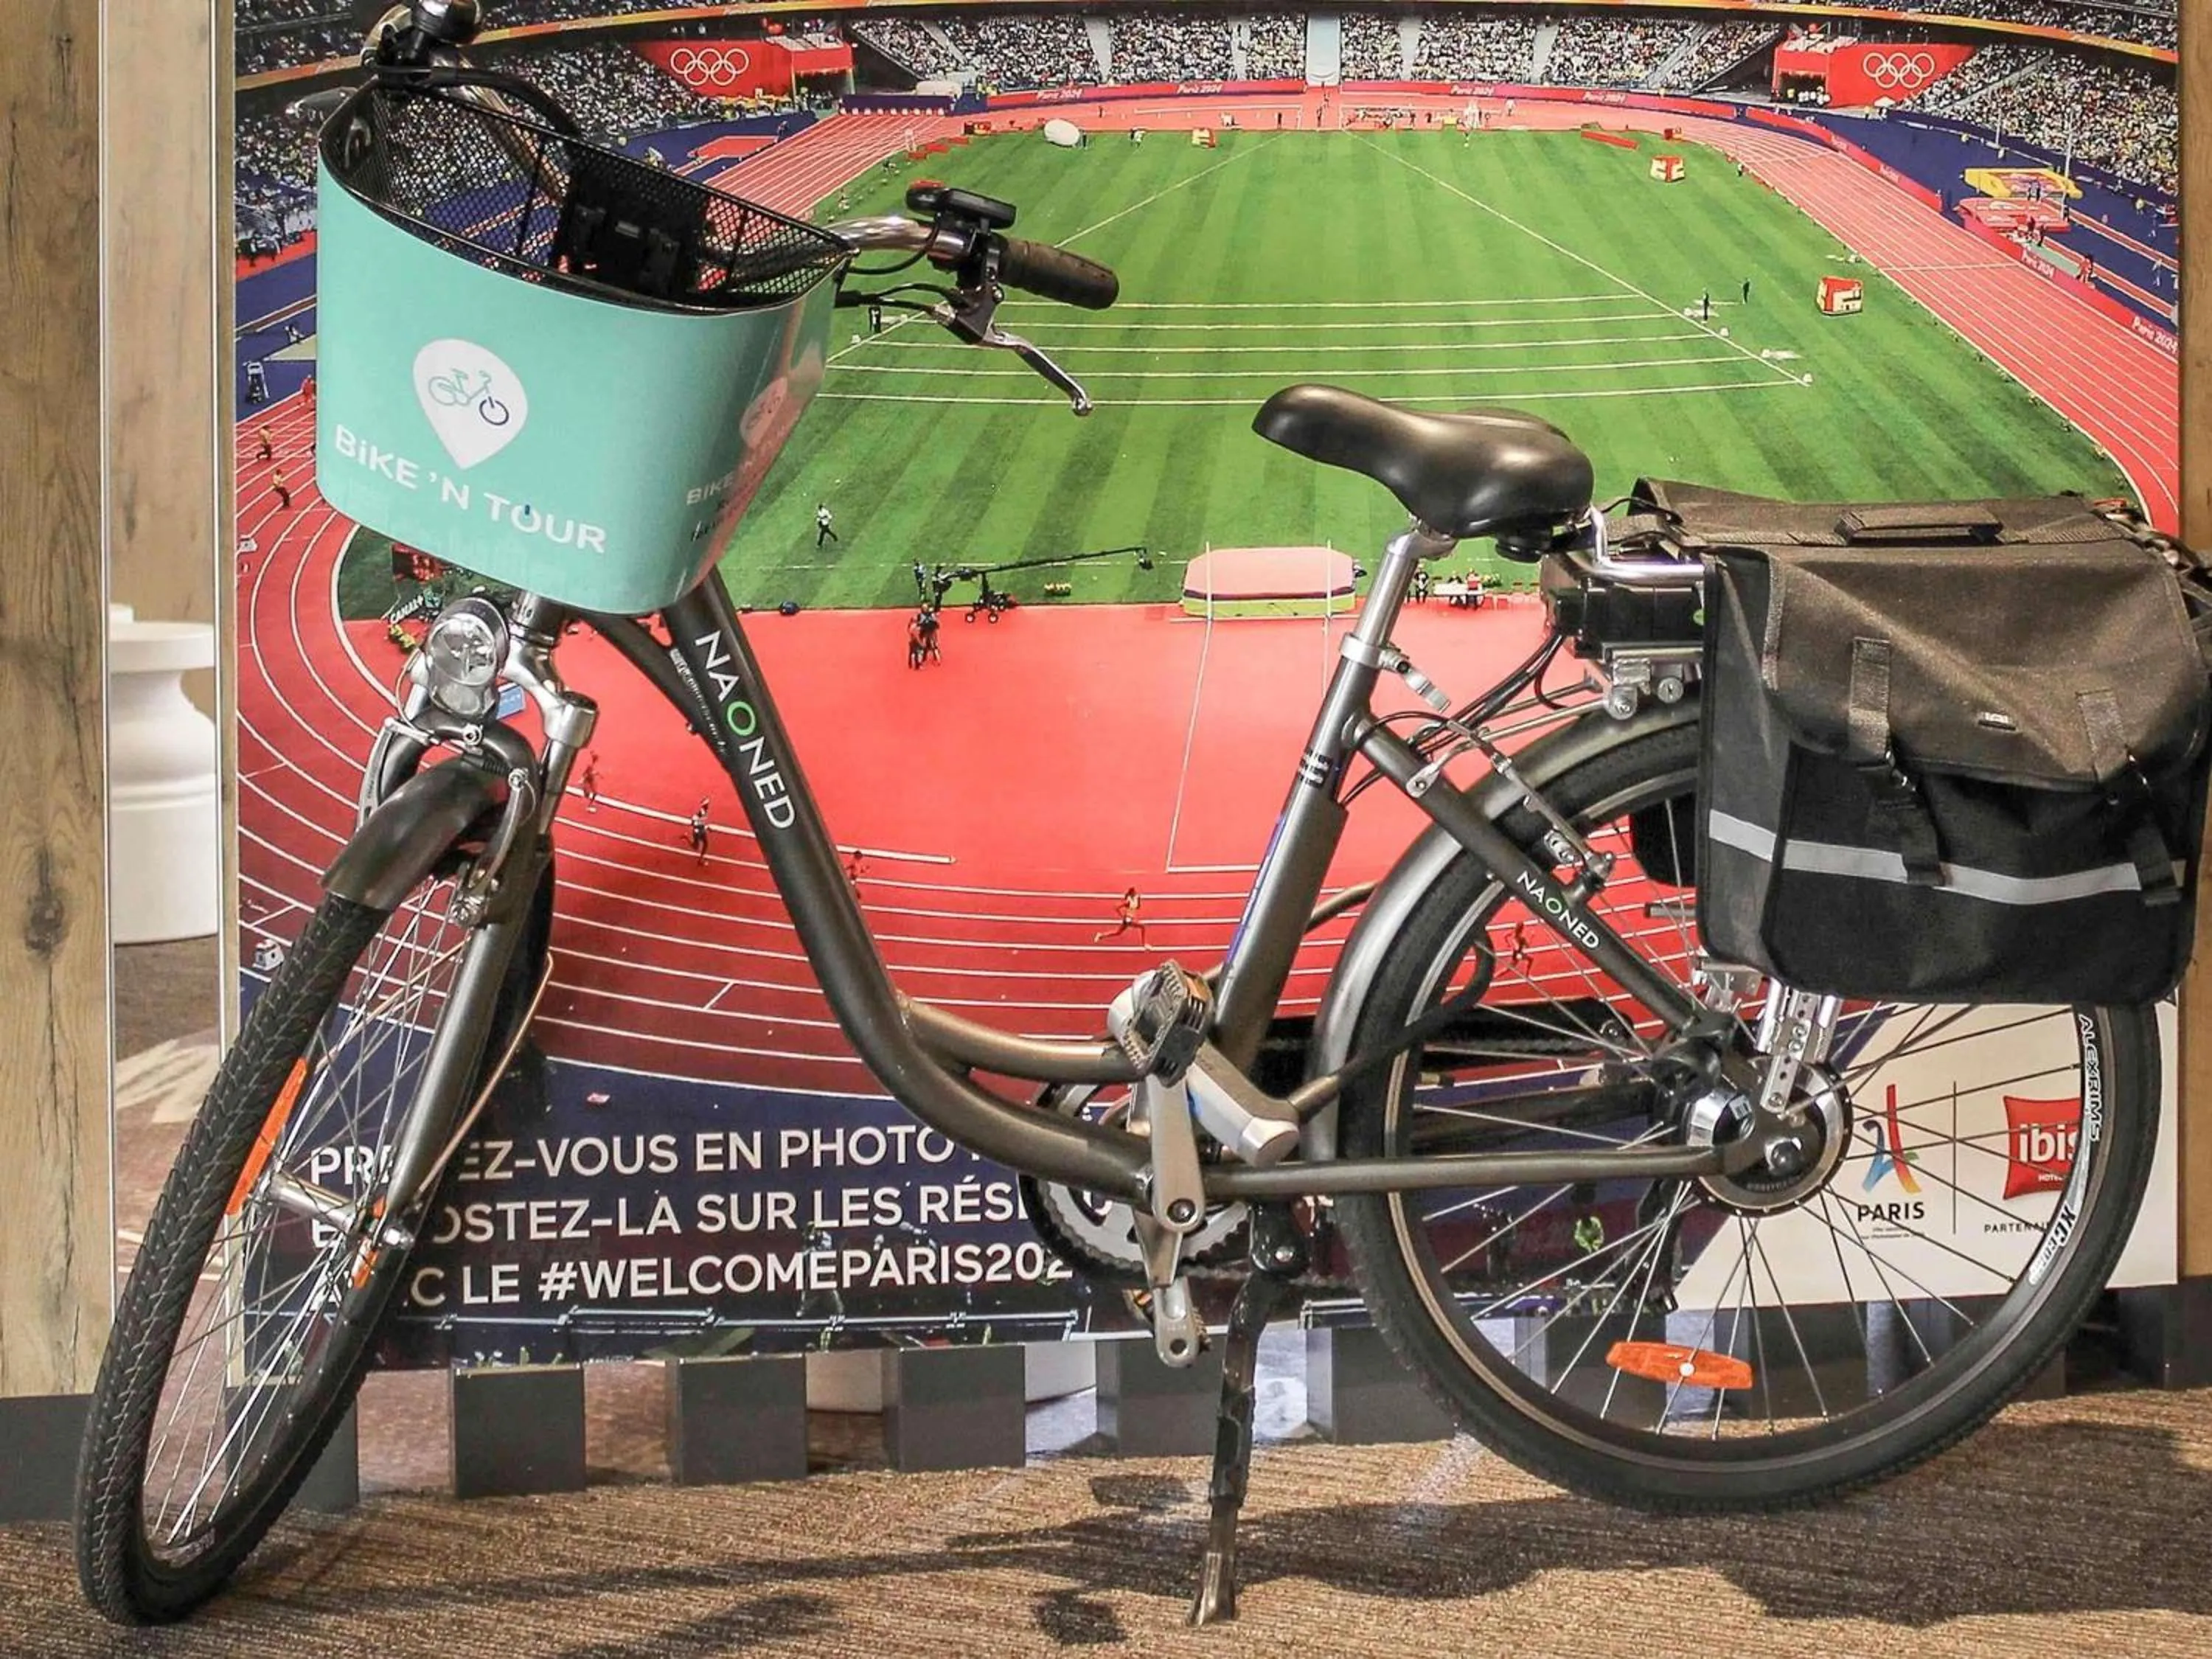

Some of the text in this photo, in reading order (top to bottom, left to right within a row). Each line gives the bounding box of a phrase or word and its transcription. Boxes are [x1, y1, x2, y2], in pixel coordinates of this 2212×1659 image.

[484, 492, 608, 554] TOUR
[695, 630, 797, 829] NAONED
[1517, 871, 1599, 949] NAONED
[310, 1125, 955, 1185] PREZ-VOUS EN PHOTO
[432, 1174, 1029, 1243] OSTEZ-LA SUR LES RÉS
[1857, 1201, 1924, 1221] PARIS
[462, 1265, 520, 1304] LE
[538, 1242, 1074, 1302] #WELCOMEPARIS202
